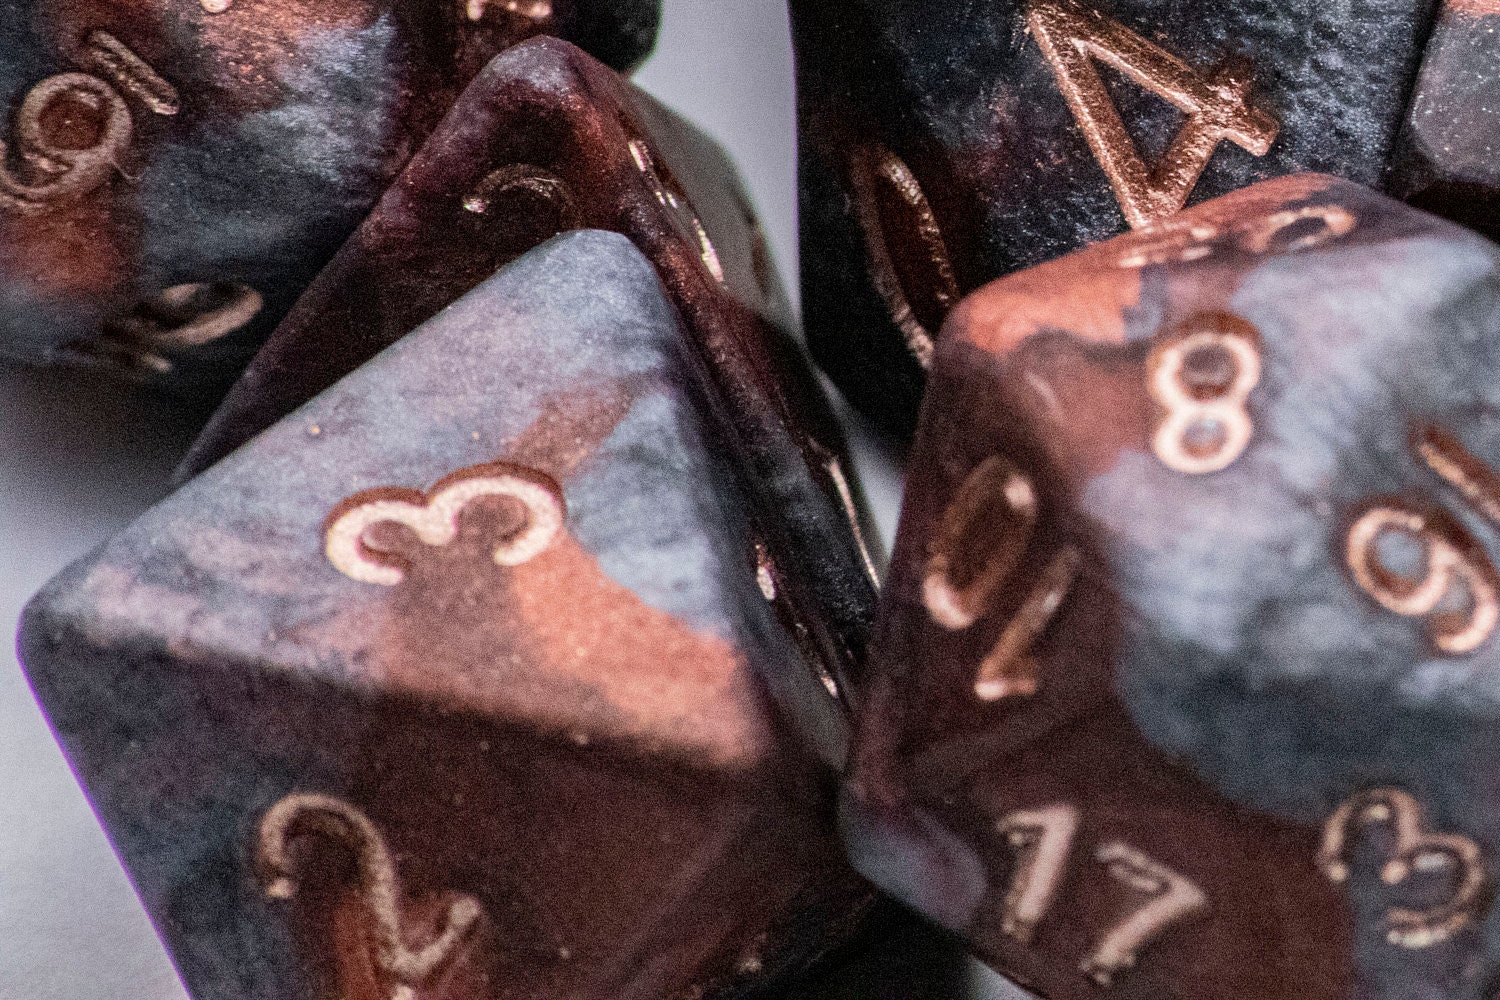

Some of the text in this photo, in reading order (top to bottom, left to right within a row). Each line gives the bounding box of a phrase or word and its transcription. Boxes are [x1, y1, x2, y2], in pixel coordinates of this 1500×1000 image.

[1149, 318, 1262, 475] 8
[325, 465, 565, 586] 3
[1002, 805, 1207, 984] 17
[1319, 788, 1490, 950] 3
